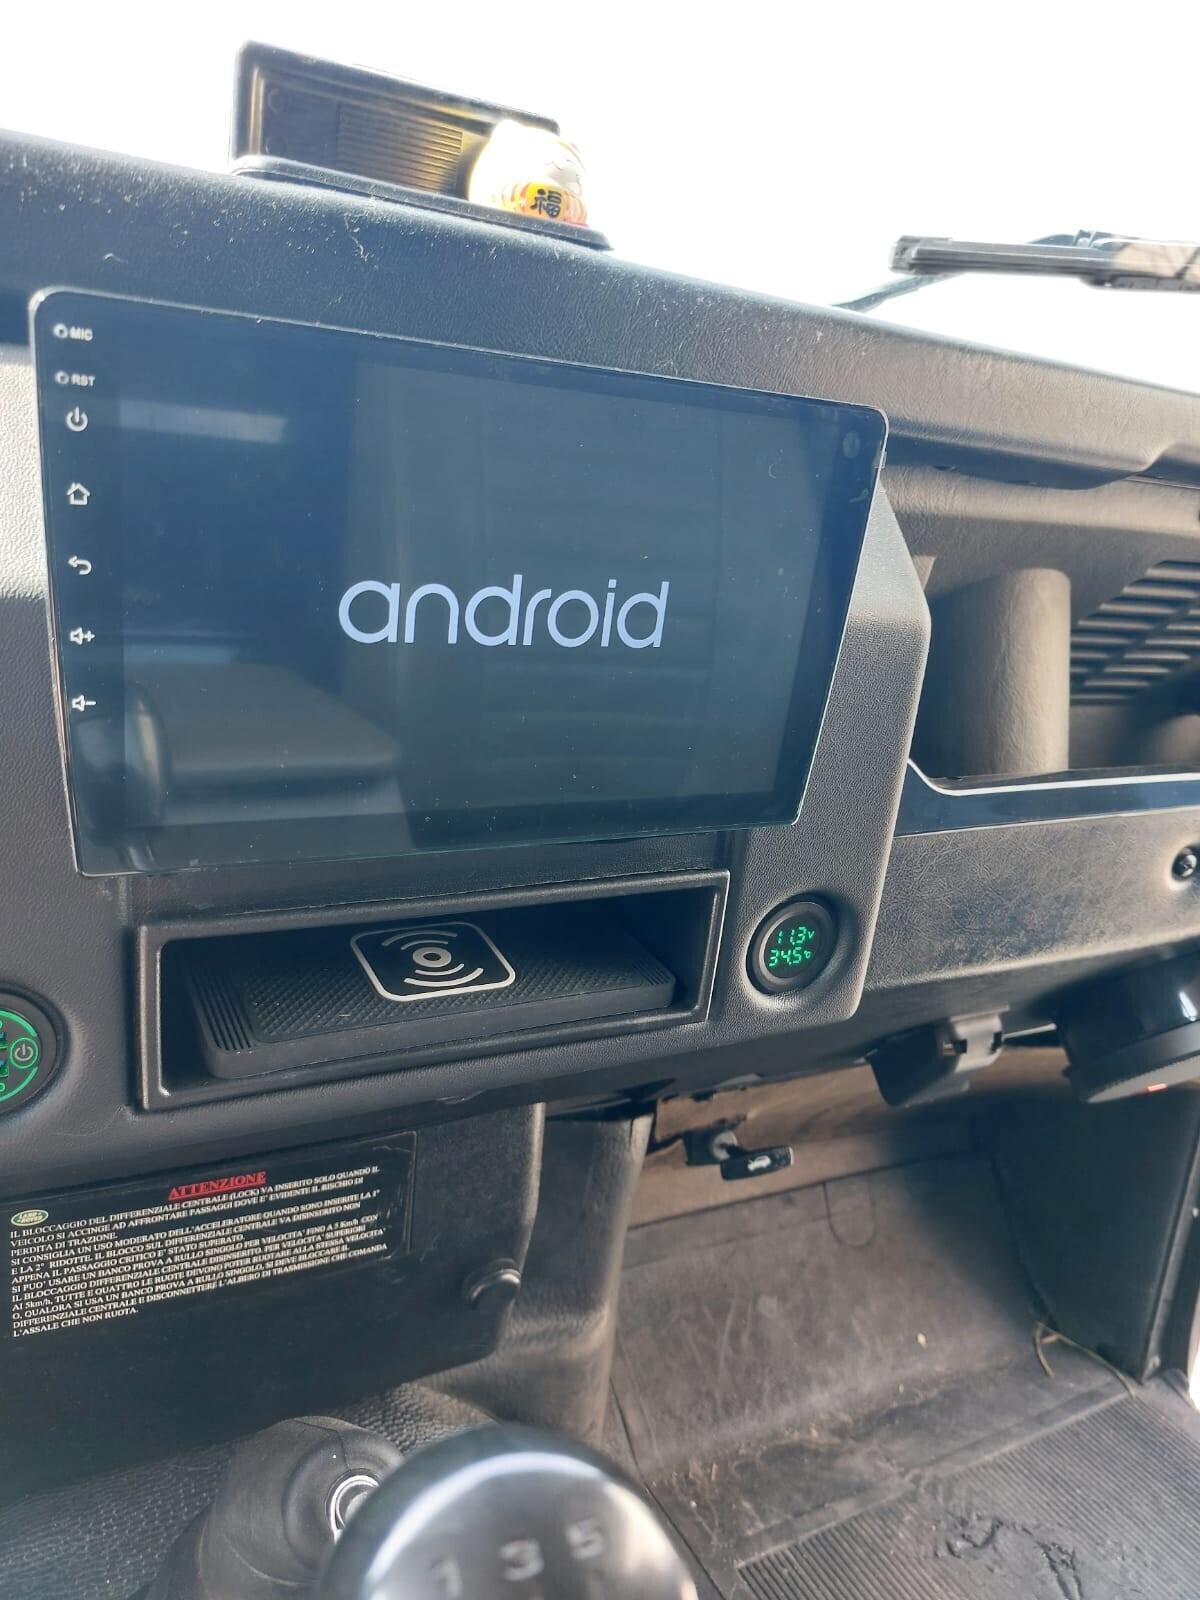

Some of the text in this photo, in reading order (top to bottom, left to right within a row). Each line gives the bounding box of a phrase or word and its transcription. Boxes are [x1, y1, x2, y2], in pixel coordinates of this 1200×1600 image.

[530, 188, 562, 218] 福
[69, 326, 93, 341] MIC
[71, 373, 96, 387] RST
[338, 574, 670, 649] android
[168, 1171, 266, 1200] ATTENZIONE
[10, 1230, 20, 1239] IL
[22, 1218, 86, 1237] BLOCCAGGIO
[89, 1215, 107, 1225] DEL
[109, 1202, 180, 1222] DIFFERENZIALE
[181, 1193, 230, 1209] CENTRALE
[10, 1233, 54, 1248] VEICOLO
[56, 1231, 65, 1240] SI
[67, 1223, 110, 1238] ACCINGE
[111, 1221, 126, 1230] AD
[127, 1209, 188, 1227] AFFRONTARE
[190, 1201, 232, 1216] PASSAGGI
[11, 1257, 20, 1266] SI
[22, 1247, 75, 1264] CONSIGLIA
[77, 1244, 91, 1254] UN
[93, 1240, 113, 1251] USO
[114, 1231, 166, 1248] MODERATO
[168, 1212, 261, 1237] DELL'ACCELERATORE
[11, 1242, 52, 1257] PERDITA
[55, 1240, 65, 1249] DI
[11, 1267, 18, 1275] E
[20, 1264, 33, 1274] LA
[94, 1251, 104, 1260] IL
[106, 1244, 143, 1258] BLOCCO
[145, 1240, 163, 1251] SUL
[165, 1226, 232, 1247] DIFFERENZIALE
[11, 1270, 50, 1284] APPENA
[52, 1268, 61, 1277] IL
[64, 1258, 117, 1275] PASSAGGIO
[118, 1250, 156, 1264] CRITICO
[168, 1242, 197, 1255] STATO
[11, 1285, 20, 1293] SI
[48, 1273, 80, 1287] USARE
[82, 1270, 96, 1280] UN
[98, 1264, 130, 1277] BANCO
[132, 1257, 163, 1271] PROVA
[164, 1256, 171, 1265] A
[174, 1249, 203, 1263] RULLO
[12, 1293, 21, 1302] IL
[24, 1281, 87, 1300] BLOCCAGGIO
[89, 1267, 160, 1288] DIFFERENZIALE
[161, 1257, 208, 1274] CENTRALE
[12, 1302, 22, 1311] AI
[54, 1290, 85, 1303] TUTTE
[87, 1288, 93, 1297] E
[94, 1279, 139, 1295] QUATTRO
[141, 1277, 152, 1286] LE
[154, 1271, 184, 1284] RUOTE
[185, 1263, 222, 1277] DEVONO
[12, 1307, 87, 1328] DIFFERENZIALE
[88, 1297, 136, 1314] CENTRALE
[138, 1295, 144, 1304] E
[146, 1280, 217, 1302] DISCONNETTERE
[24, 1302, 70, 1318] QUALORA
[73, 1299, 82, 1308] SI
[84, 1295, 103, 1306] USA
[105, 1292, 119, 1302] UN
[121, 1285, 153, 1299] BANCO
[154, 1279, 185, 1292] PROVA
[186, 1277, 193, 1286] A
[194, 1271, 223, 1284] RULLO
[13, 1305, 138, 1337] L'ASSALE CHE NON RUOTA.
[500, 1539, 544, 1581] 3
[566, 1519, 604, 1560] 5
